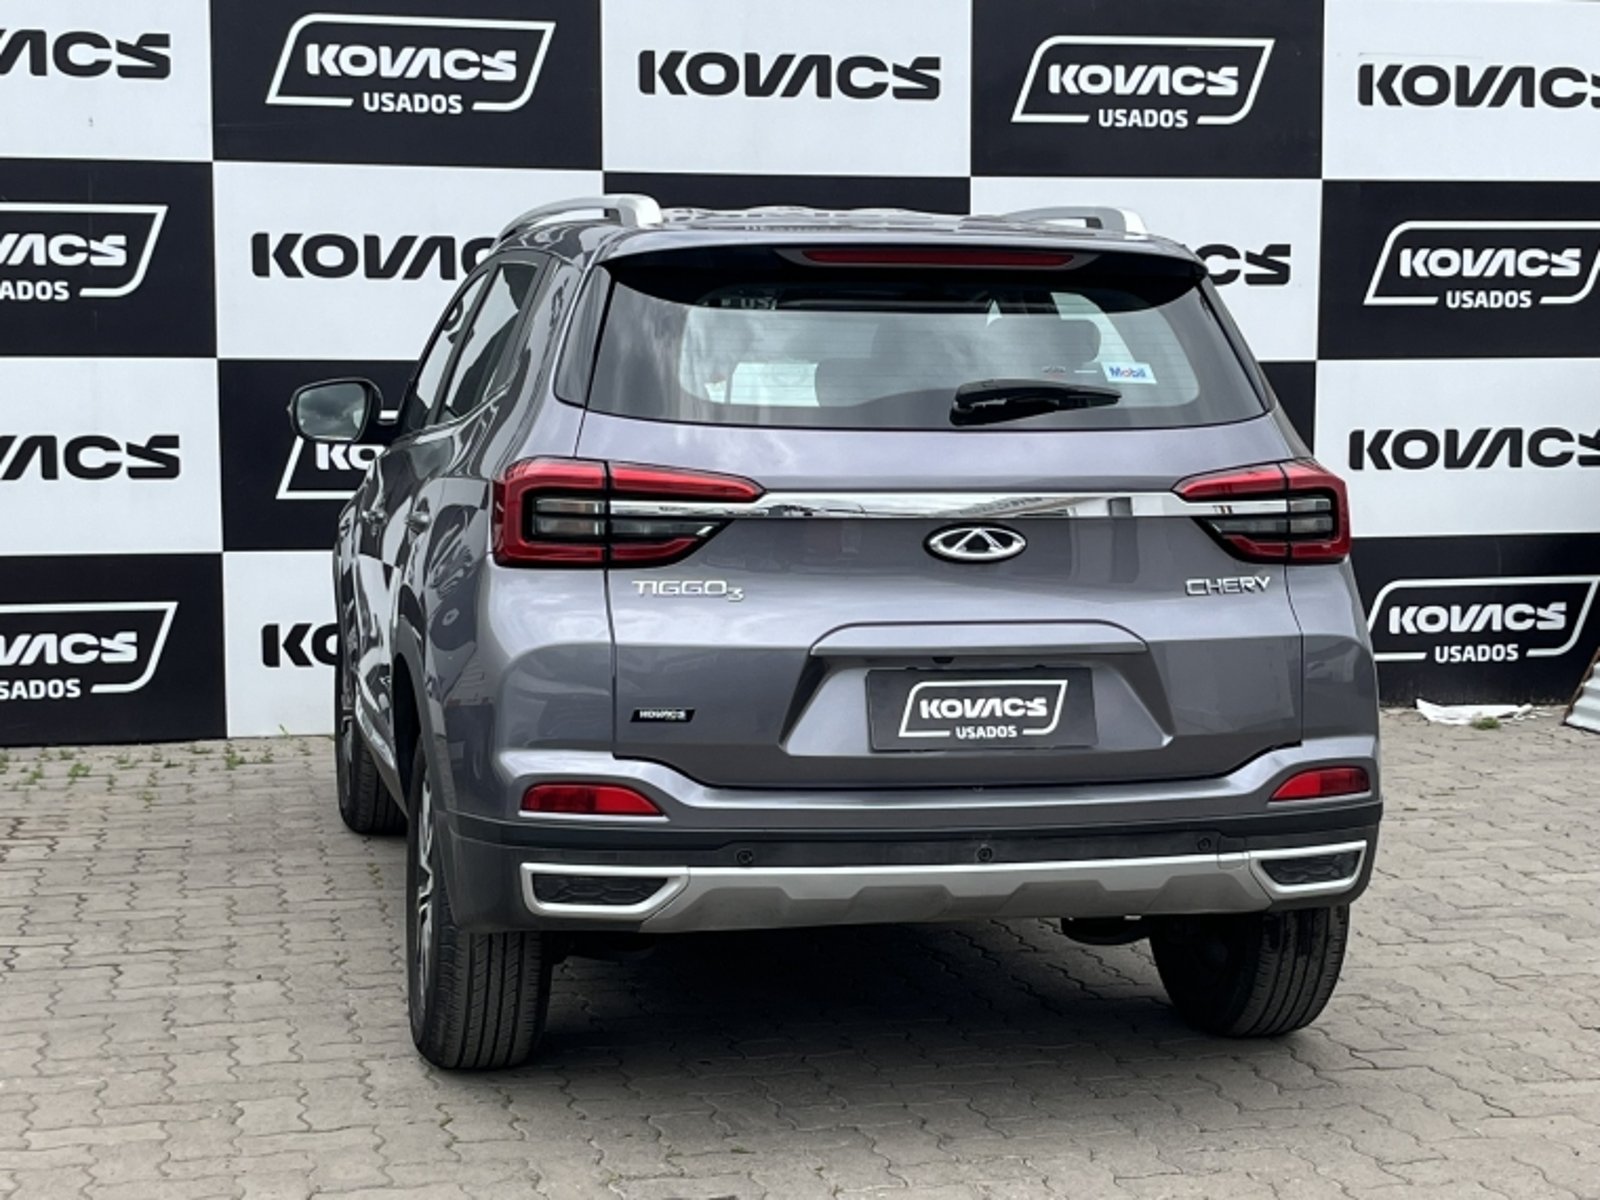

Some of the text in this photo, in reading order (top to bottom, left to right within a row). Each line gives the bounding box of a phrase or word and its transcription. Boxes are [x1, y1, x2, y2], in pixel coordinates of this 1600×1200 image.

[0, 29, 170, 79] ACS
[306, 44, 516, 80] KOVACS
[638, 50, 940, 100] KOVACS
[1049, 64, 1239, 95] KOVACS
[1358, 64, 1600, 108] KOVAC
[363, 93, 462, 114] USADOS
[1098, 109, 1188, 128] USADOS
[1400, 248, 1581, 277] KOVACS
[1446, 290, 1531, 309] USADOS
[1109, 366, 1146, 378] Mobil
[1186, 576, 1270, 595] CHERY
[1389, 602, 1567, 634] KOVACS
[1435, 644, 1518, 663] USADOS
[919, 697, 1048, 719] KOVACS
[955, 726, 1018, 740] USADOS
